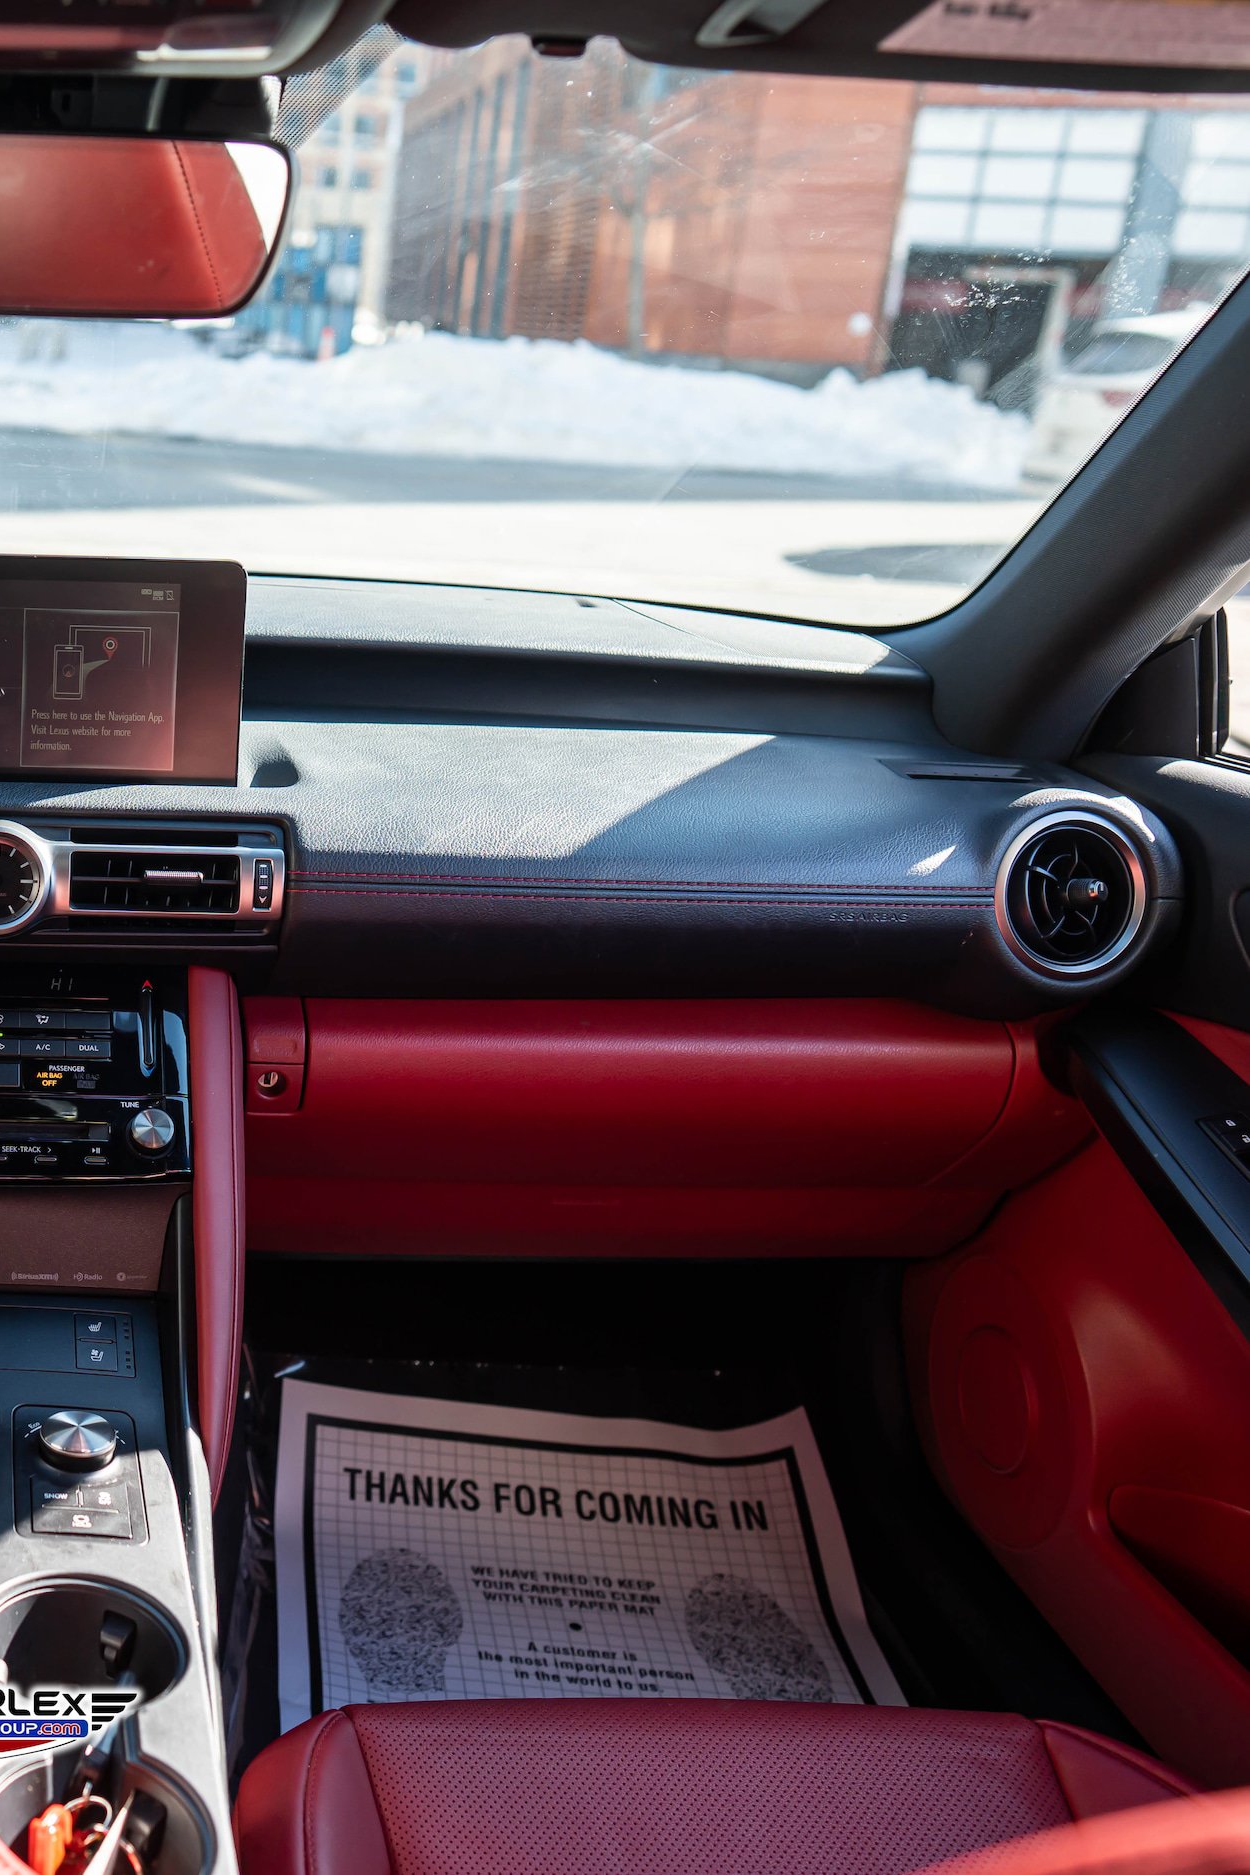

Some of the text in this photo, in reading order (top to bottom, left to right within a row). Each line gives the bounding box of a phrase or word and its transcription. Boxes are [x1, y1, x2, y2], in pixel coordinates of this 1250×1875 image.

[31, 709, 165, 724] Press here to use the Navigation App.
[31, 724, 132, 737] Visit Lexus website for more
[30, 740, 72, 751] information.
[828, 911, 855, 922] SRS
[35, 1043, 51, 1051] A/C
[120, 1101, 140, 1109] TUNE
[343, 1467, 770, 1531] THANKS FOR COMING IN
[471, 1565, 656, 1591] WE HAVE TRIED TO KEEP
[472, 1578, 661, 1605] YOUR CARPETING CLEAN
[483, 1591, 656, 1616] WITH THIS PAPER MAT
[528, 1641, 638, 1662] A customer is
[478, 1651, 695, 1681] the most important person
[514, 1668, 529, 1680] in
[535, 1670, 561, 1683] the
[566, 1674, 612, 1689] world
[617, 1679, 633, 1691] to
